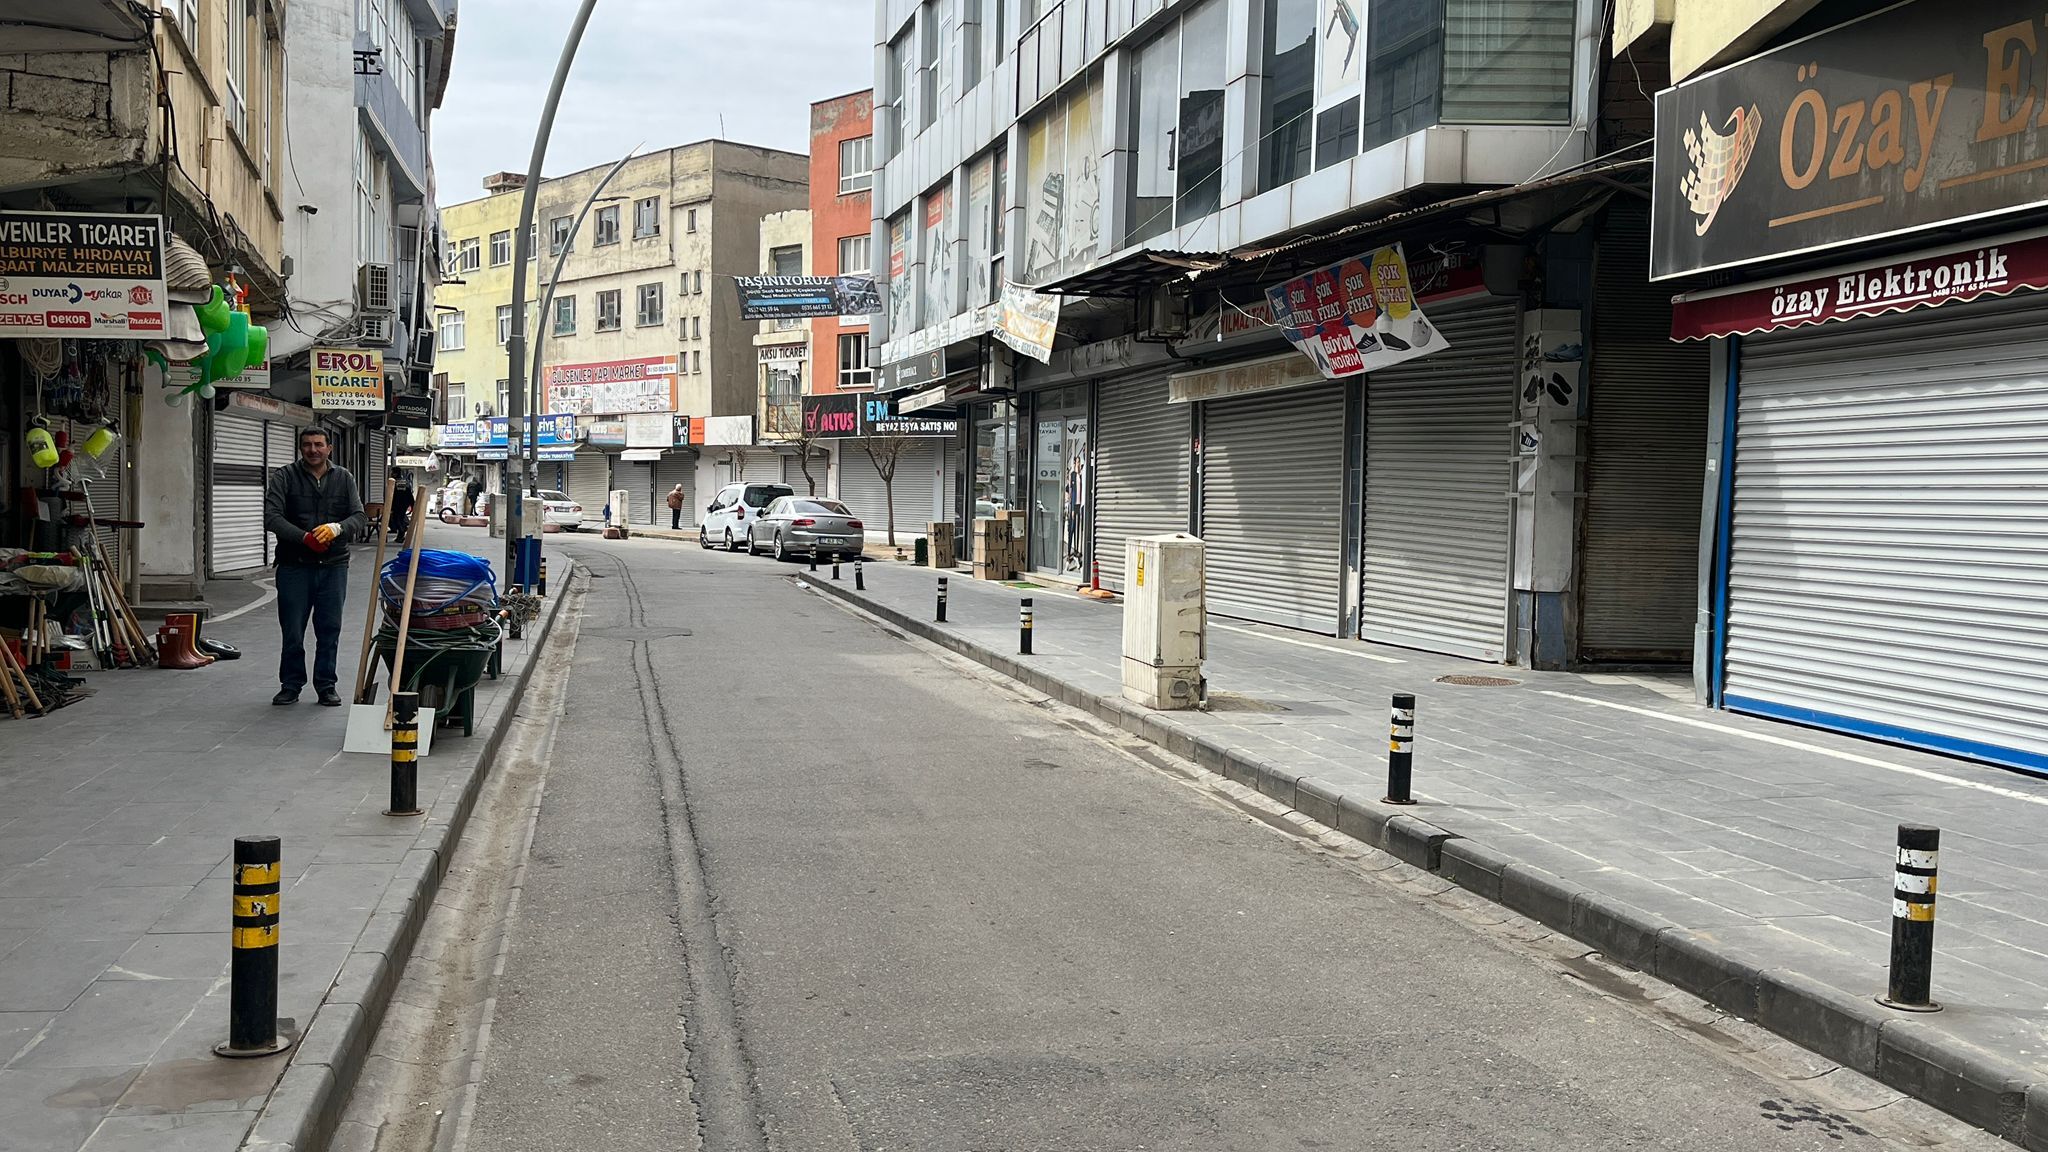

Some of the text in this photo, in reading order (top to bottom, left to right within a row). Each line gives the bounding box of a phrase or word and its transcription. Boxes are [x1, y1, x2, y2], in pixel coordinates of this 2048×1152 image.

[1779, 60, 1954, 193] Özay
[73, 248, 152, 262] HIRDAVAT
[1377, 264, 1400, 285] ŞOK
[1836, 249, 2009, 306] Elektronik
[32, 288, 69, 298] DUYAR
[1315, 281, 1333, 302] ŞOK
[1345, 274, 1365, 296] ŞOK
[1290, 289, 1306, 309] ŞOK
[1347, 296, 1375, 315] FİYAT
[94, 316, 126, 325] Marshall
[128, 316, 162, 325] makita
[759, 347, 777, 361] AKSU
[1323, 333, 1355, 355] BÜYÜK
[316, 352, 379, 373] EROL
[1329, 351, 1361, 371] İNDİRİM
[594, 366, 611, 382] YAPI
[611, 364, 646, 381] MARKET
[820, 412, 856, 432] ALTUS
[875, 422, 899, 432] BEYAZ
[900, 422, 918, 433] EŞYA
[919, 421, 942, 433] SATIŞ
